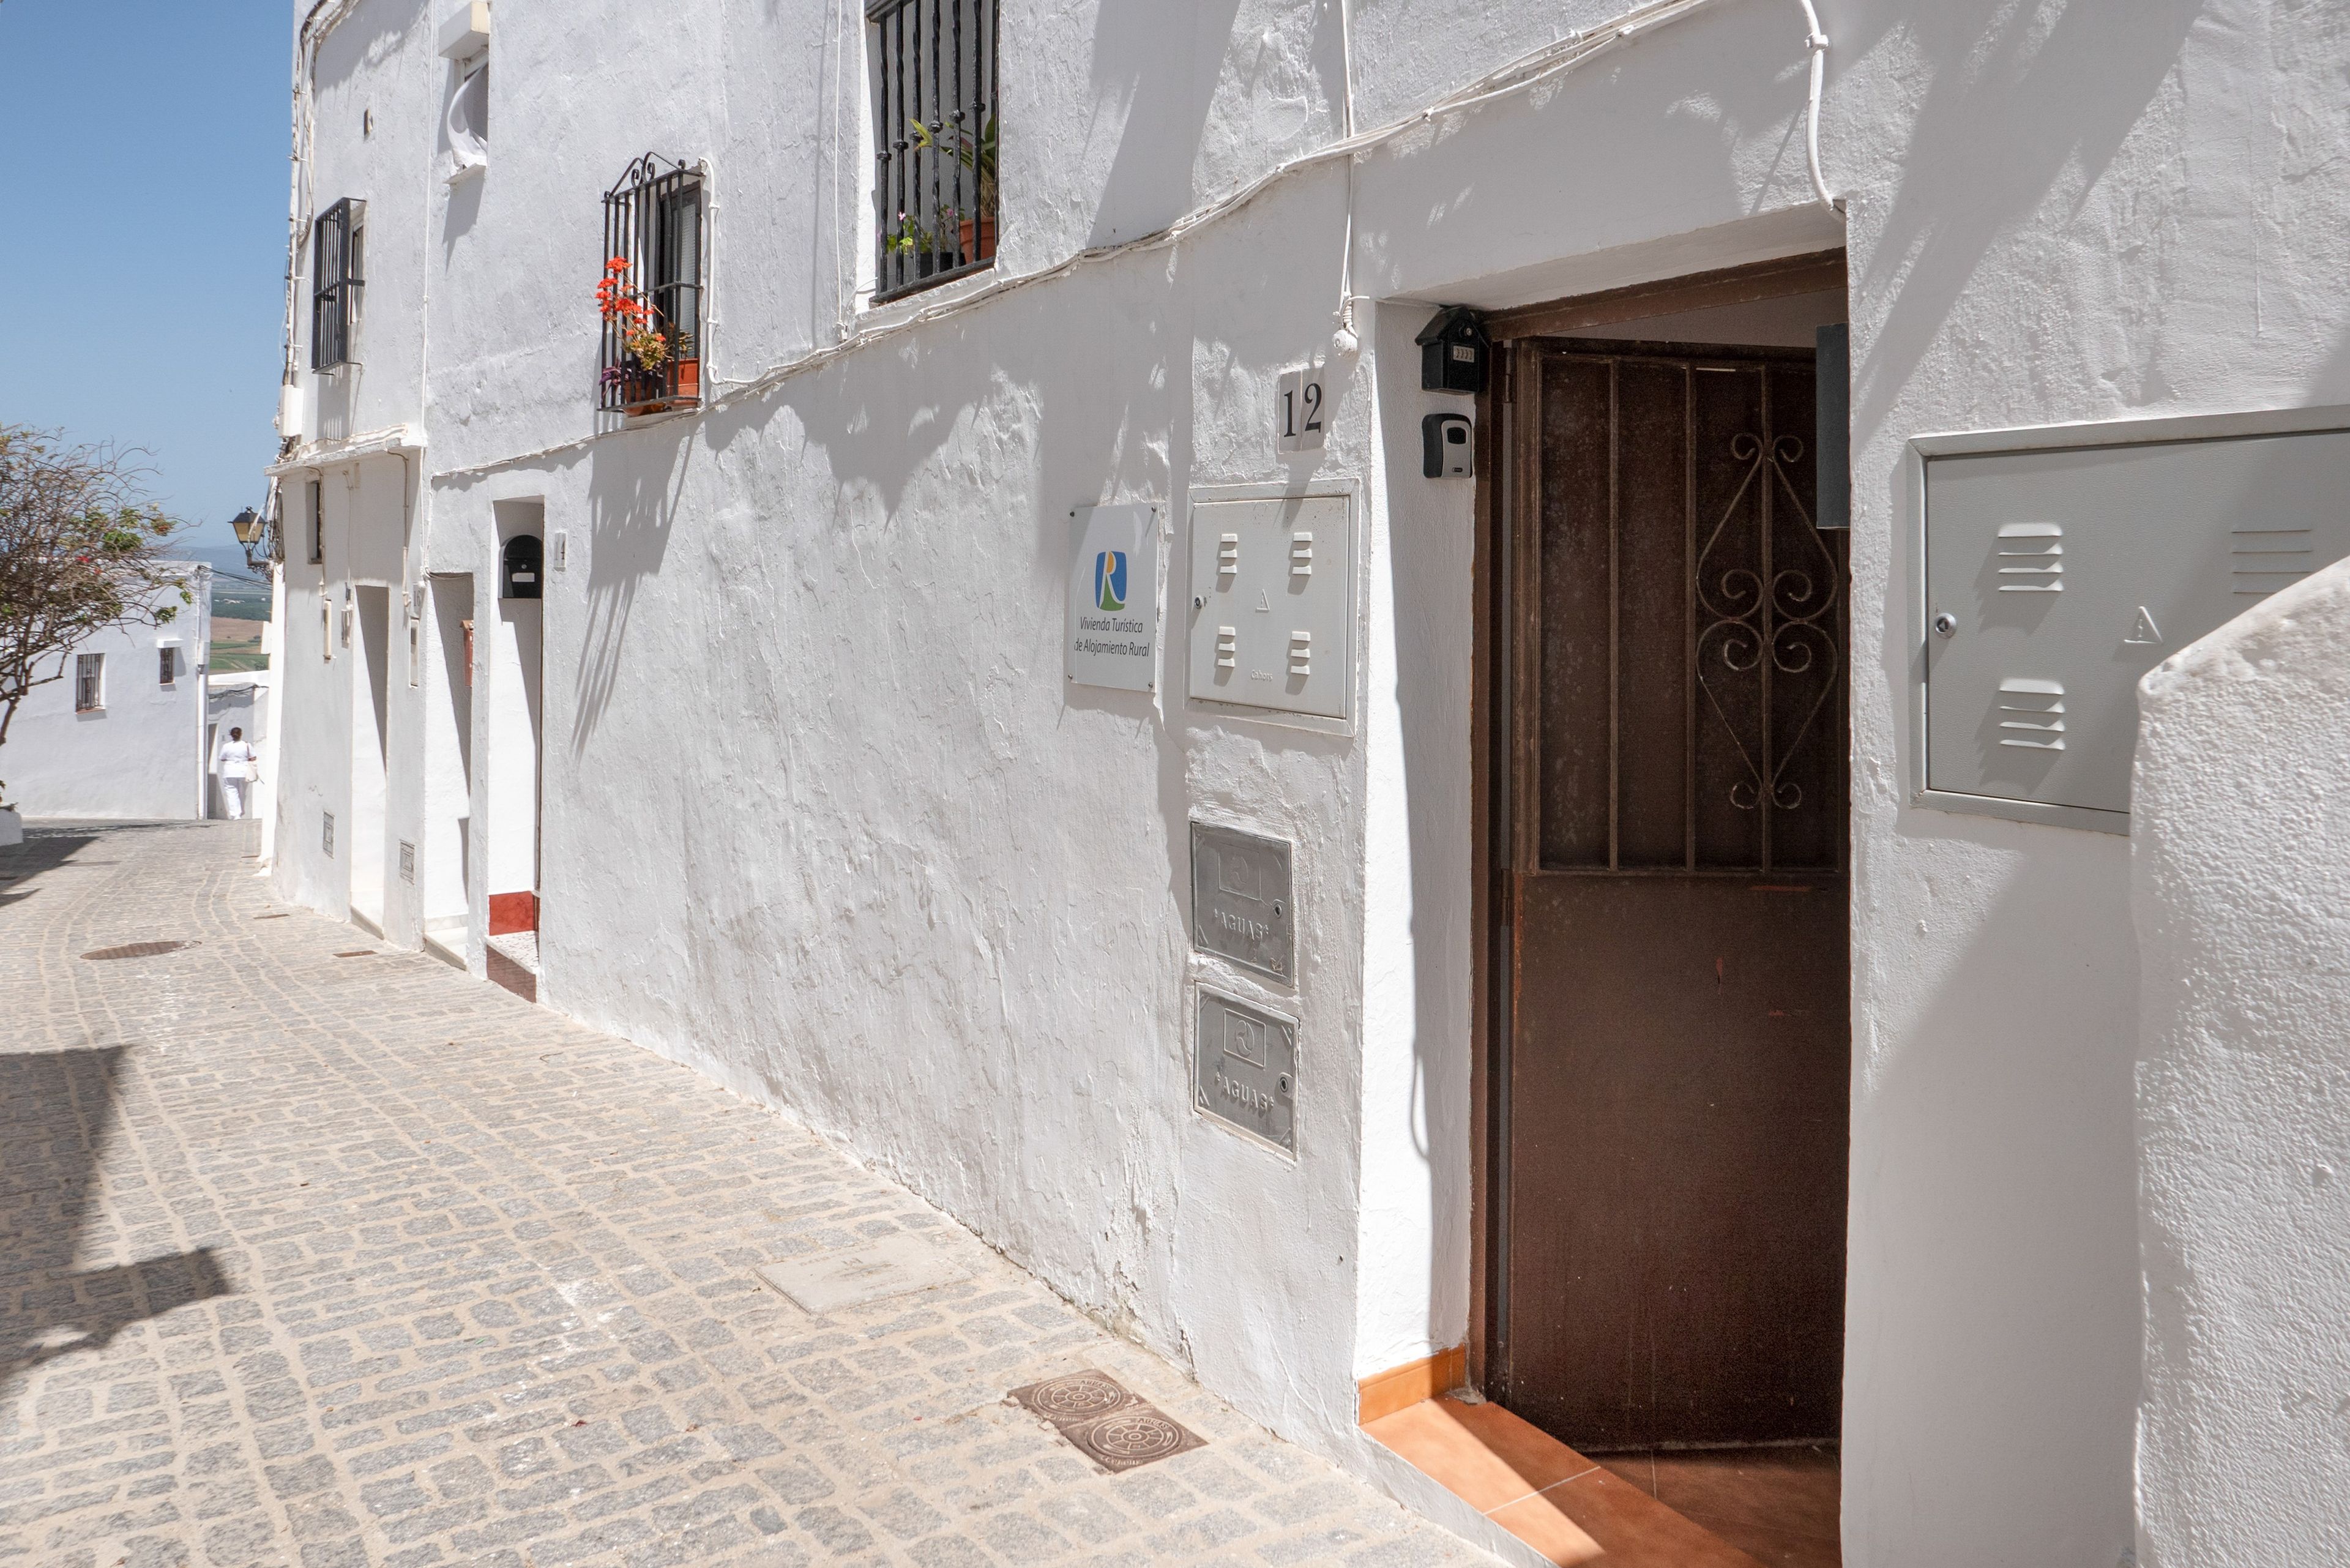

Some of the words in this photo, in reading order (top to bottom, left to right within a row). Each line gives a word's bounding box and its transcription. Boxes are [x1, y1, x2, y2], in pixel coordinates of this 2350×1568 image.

[1283, 382, 1322, 438] 12
[554, 540, 565, 561] 14
[1080, 616, 1110, 631] Vivienda
[1112, 618, 1143, 633] Turística
[1074, 638, 1083, 652] de
[1083, 638, 1127, 656] Alojamiento
[1128, 641, 1150, 657] Rural
[1250, 669, 1273, 682] Cahors
[1220, 911, 1264, 941] AGUAS
[1220, 1076, 1268, 1111] AGUAS
